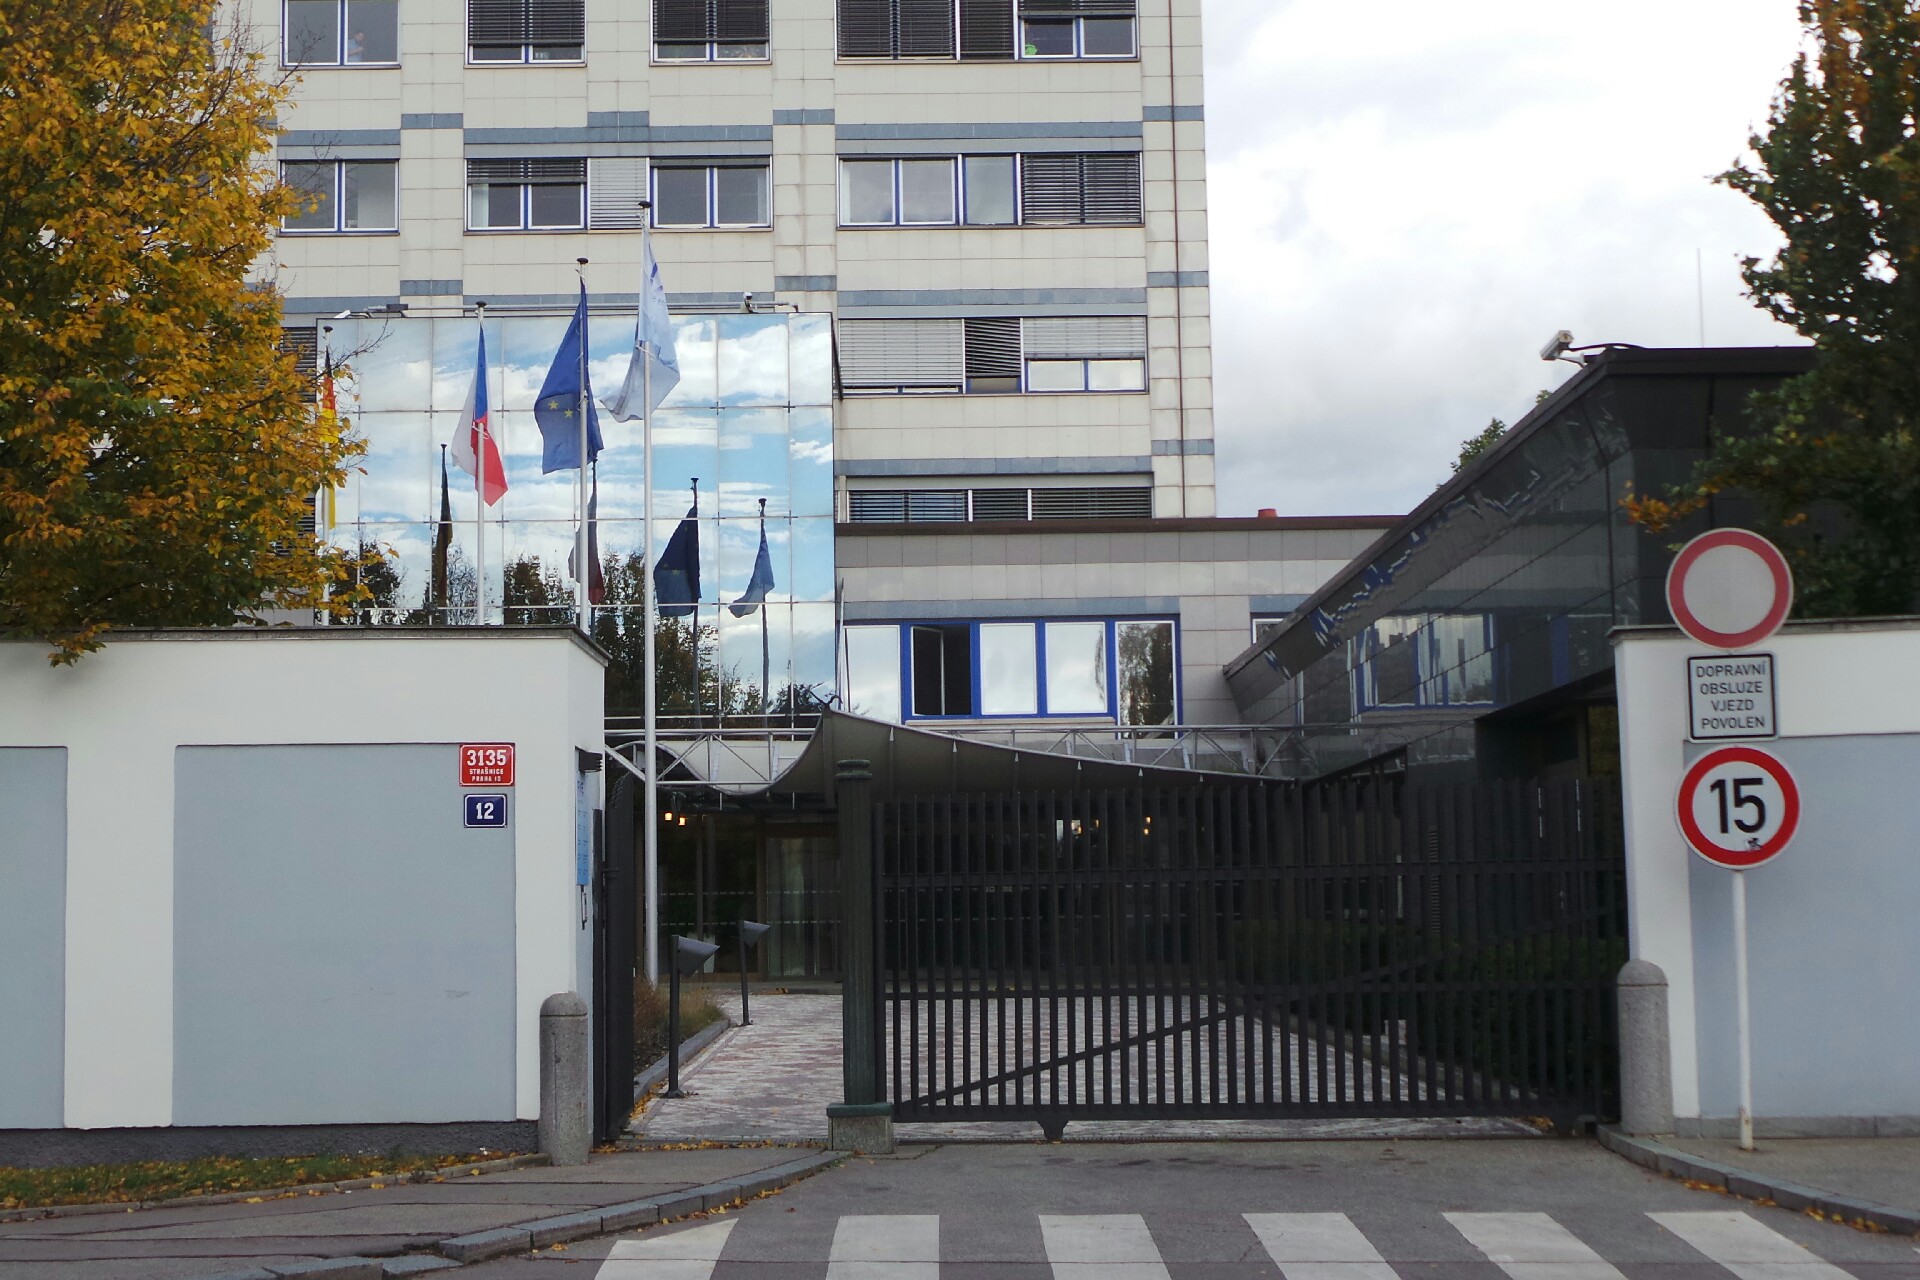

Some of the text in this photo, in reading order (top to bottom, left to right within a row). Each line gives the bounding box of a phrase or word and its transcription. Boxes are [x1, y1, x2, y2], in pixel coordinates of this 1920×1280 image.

[1696, 661, 1767, 678] DOPRAVNÍ
[1700, 682, 1763, 695] OBSLUZE
[1711, 699, 1754, 712] VJEZD
[1701, 716, 1765, 730] POVOLEN
[467, 749, 507, 766] 3135
[469, 767, 504, 775] STRAŠNICE
[476, 803, 494, 820] 12
[1710, 777, 1766, 834] 15
